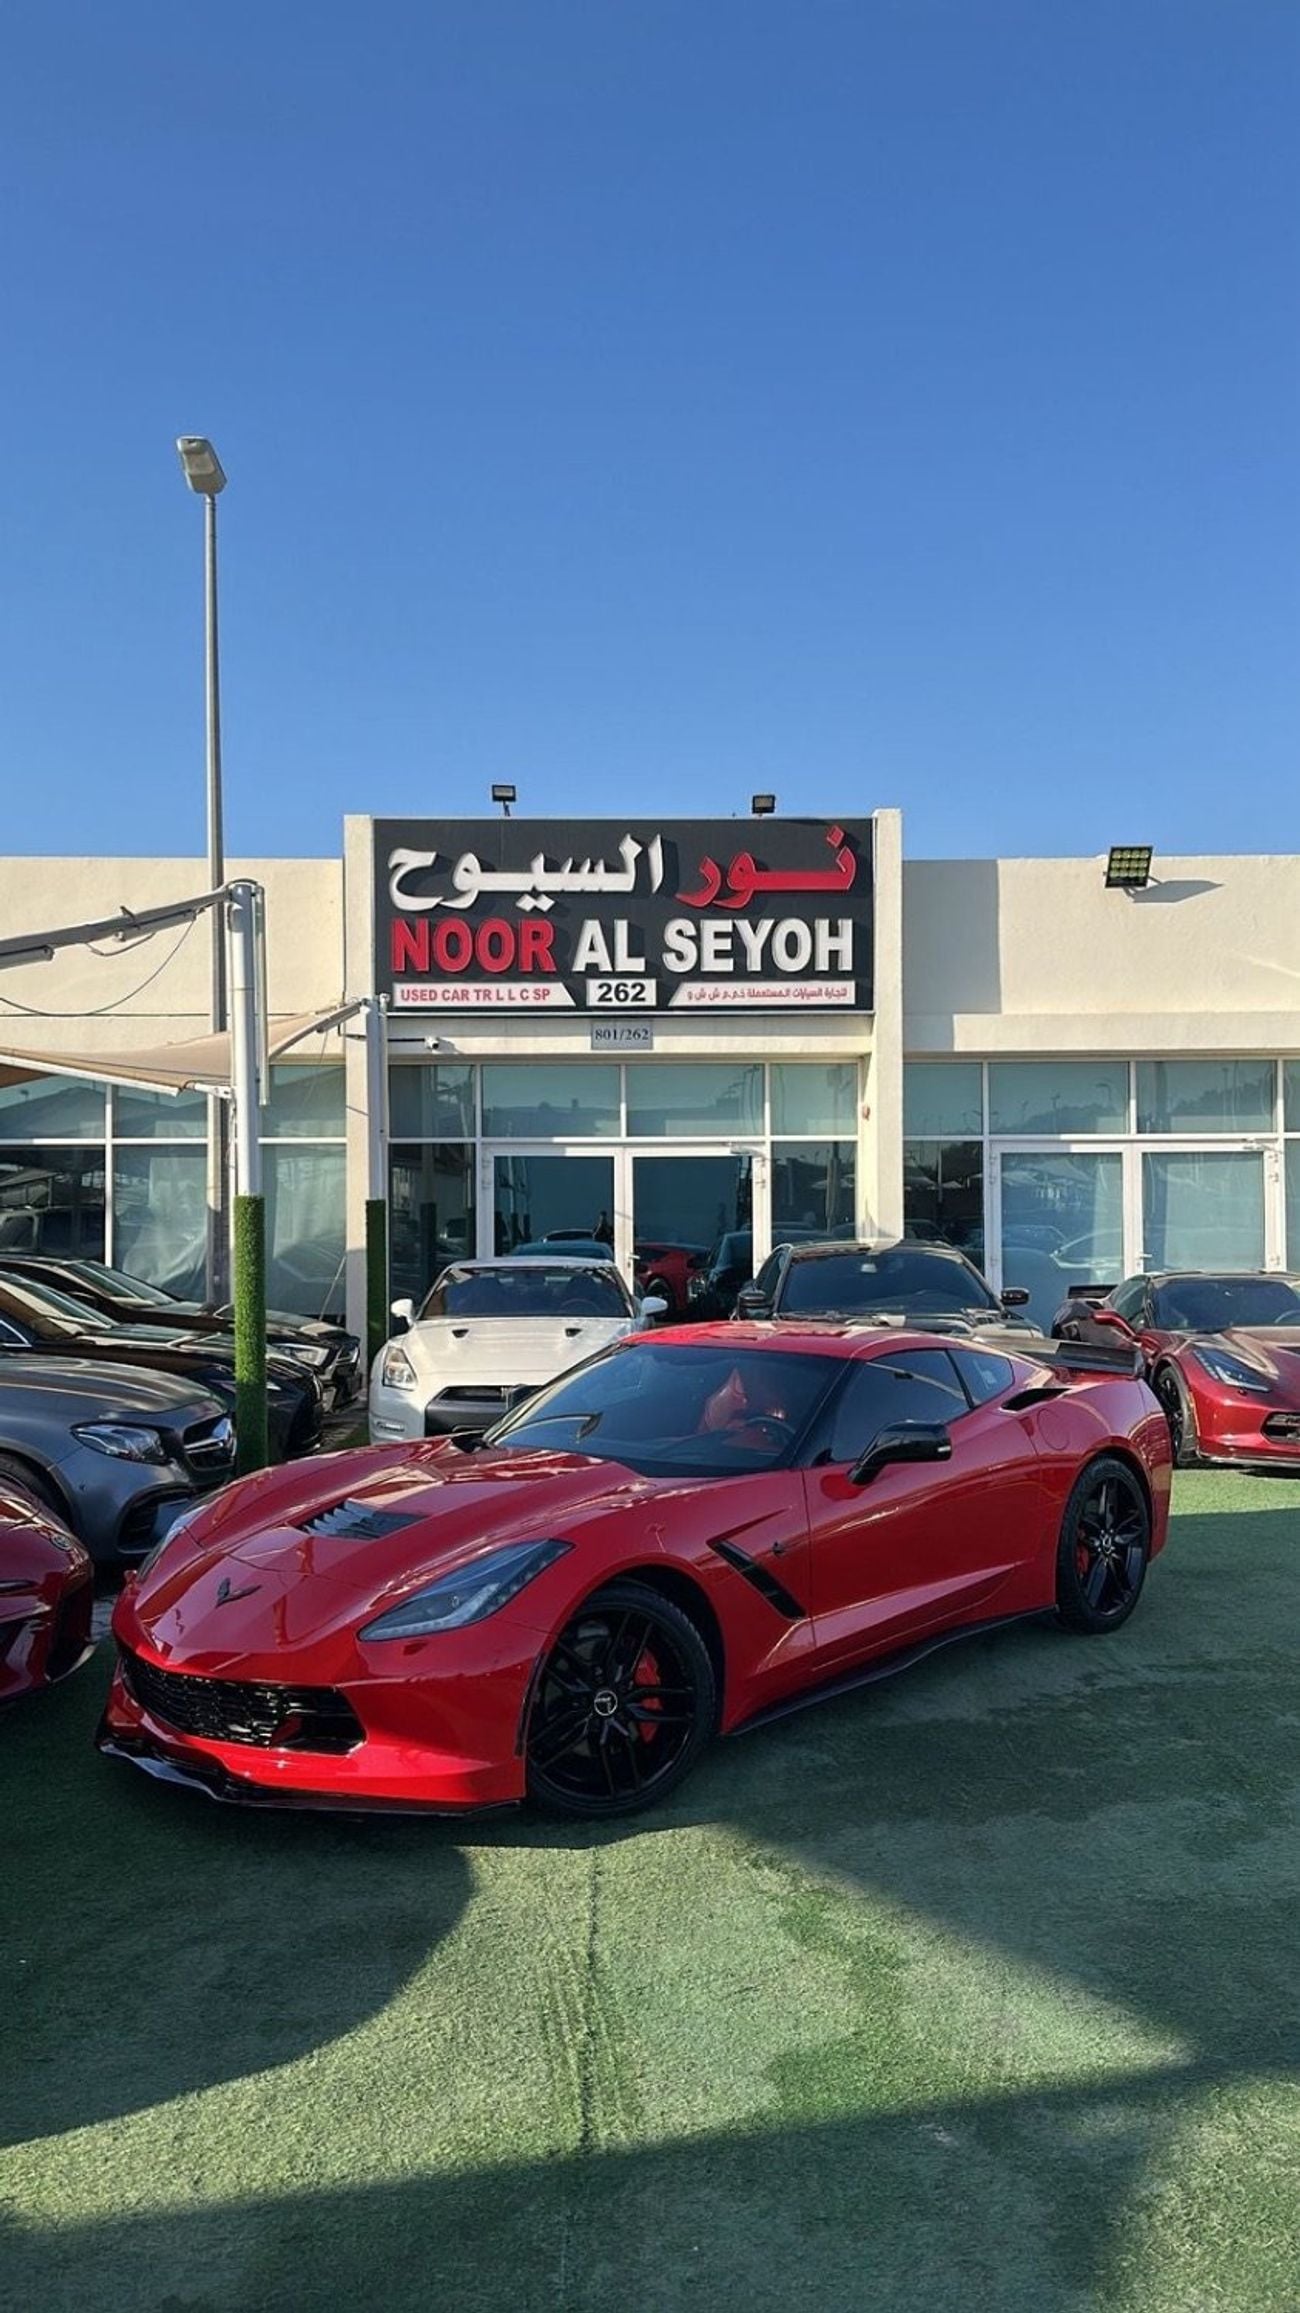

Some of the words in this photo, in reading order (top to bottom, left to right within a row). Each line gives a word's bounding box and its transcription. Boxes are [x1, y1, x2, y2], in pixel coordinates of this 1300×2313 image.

[388, 833, 664, 912] السيوح
[676, 825, 856, 909] نور
[391, 917, 557, 973] NOOR
[572, 918, 646, 972] AL
[662, 917, 853, 973] SEYOH
[401, 989, 437, 1001] USED
[441, 989, 469, 1001] CAR
[473, 989, 492, 1001] TR
[496, 988, 504, 1001] L
[508, 988, 516, 1000] L
[520, 988, 529, 1000] C
[533, 988, 550, 1000] SP
[597, 982, 646, 1002] 262
[595, 1028, 649, 1041] 801/262
